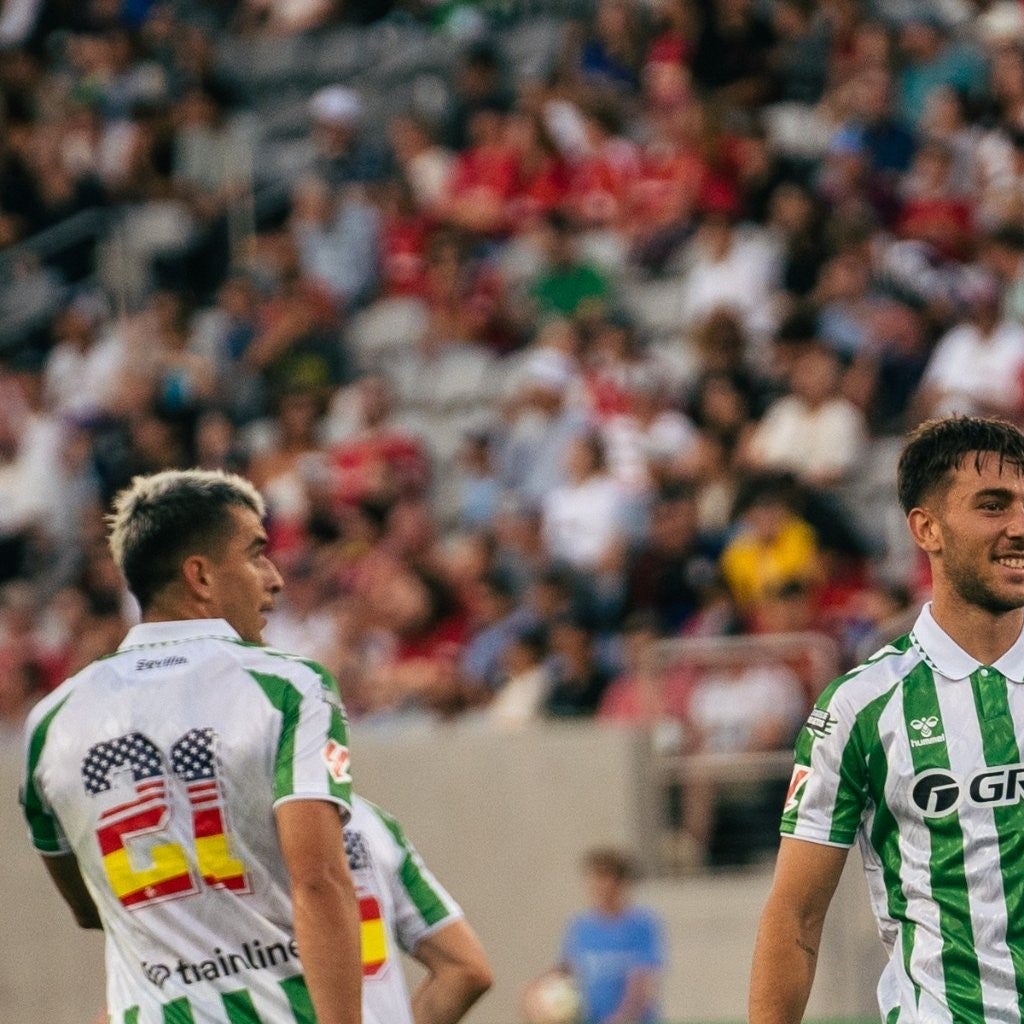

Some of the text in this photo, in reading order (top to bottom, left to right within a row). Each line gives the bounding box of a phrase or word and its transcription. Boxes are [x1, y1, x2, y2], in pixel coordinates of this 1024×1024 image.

[910, 733, 946, 749] hummel
[82, 727, 254, 912] 21
[176, 938, 301, 985] trainline
